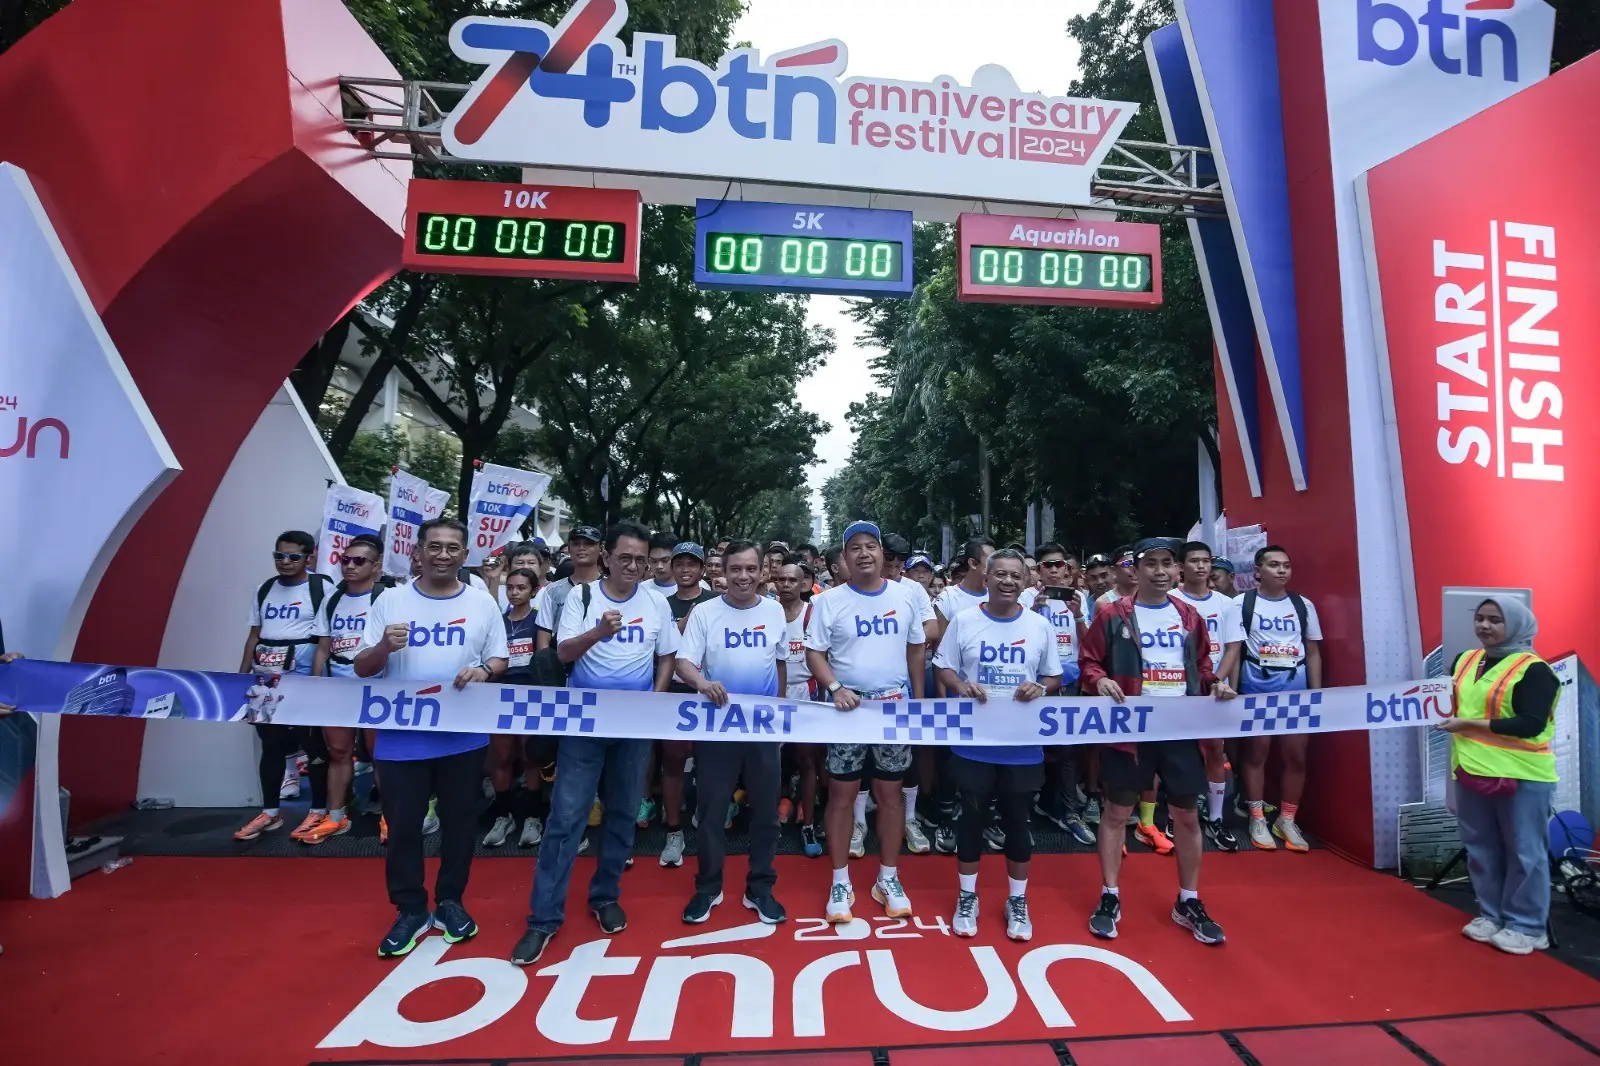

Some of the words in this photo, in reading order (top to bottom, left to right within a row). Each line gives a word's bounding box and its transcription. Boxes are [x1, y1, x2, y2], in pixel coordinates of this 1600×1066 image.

[1357, 0, 1519, 83] btn
[641, 40, 838, 145] btn
[848, 82, 1122, 134] anniversary
[850, 111, 1020, 160] festival
[1023, 135, 1086, 158] 2024
[503, 190, 548, 210] 10K
[792, 211, 824, 230] 5K
[423, 215, 475, 253] 00
[494, 219, 545, 256] 00
[564, 223, 614, 258] 00
[1008, 223, 1121, 248] Aquathlon
[713, 236, 762, 272] 00
[780, 239, 827, 274] 00
[845, 242, 892, 277] 00
[978, 249, 1023, 284] 00
[1039, 252, 1083, 287] 00
[1100, 255, 1142, 289] 00
[1433, 240, 1491, 468] START
[1504, 222, 1564, 481] FINISH
[482, 502, 501, 514] 10K
[333, 520, 348, 532] 10K
[395, 522, 413, 540] SUB
[264, 601, 302, 620] btn
[333, 612, 367, 631] btn
[854, 609, 899, 637] btn
[1259, 613, 1296, 632] btn
[408, 618, 466, 647] btn
[724, 624, 767, 649] btn
[979, 638, 1026, 665] btn
[1264, 645, 1295, 656] PACER
[98, 673, 117, 685] btn
[994, 675, 1020, 684] 53181
[1157, 671, 1183, 680] 15609
[1421, 683, 1448, 693] 2024
[358, 684, 442, 727] btn
[676, 700, 798, 735] START
[1038, 705, 1154, 737] START
[794, 915, 951, 941] 2024
